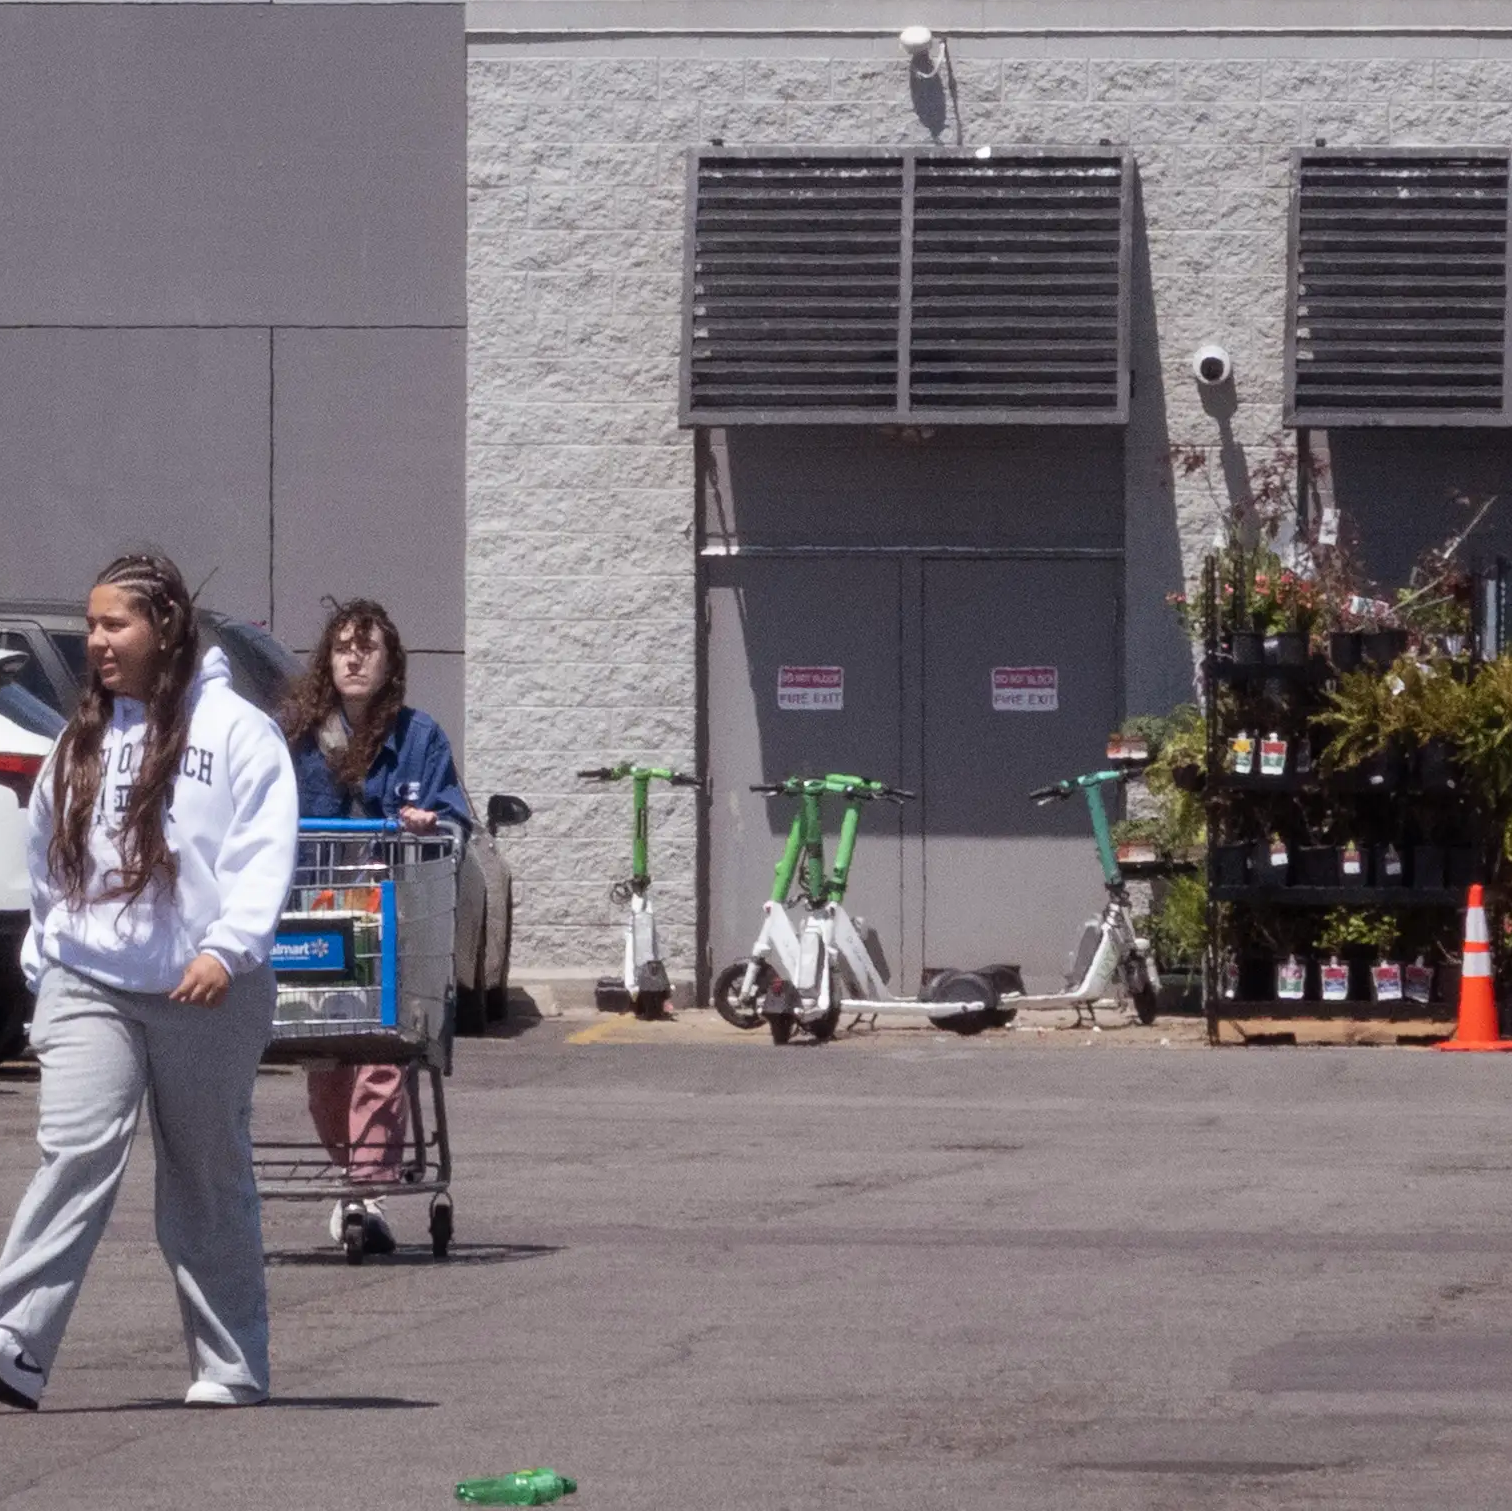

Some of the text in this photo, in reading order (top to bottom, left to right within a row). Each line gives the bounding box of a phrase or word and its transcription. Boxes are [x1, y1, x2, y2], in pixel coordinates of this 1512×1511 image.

[780, 691, 842, 705] FIRE EXIT
[994, 693, 1056, 706] FIRE EXIT
